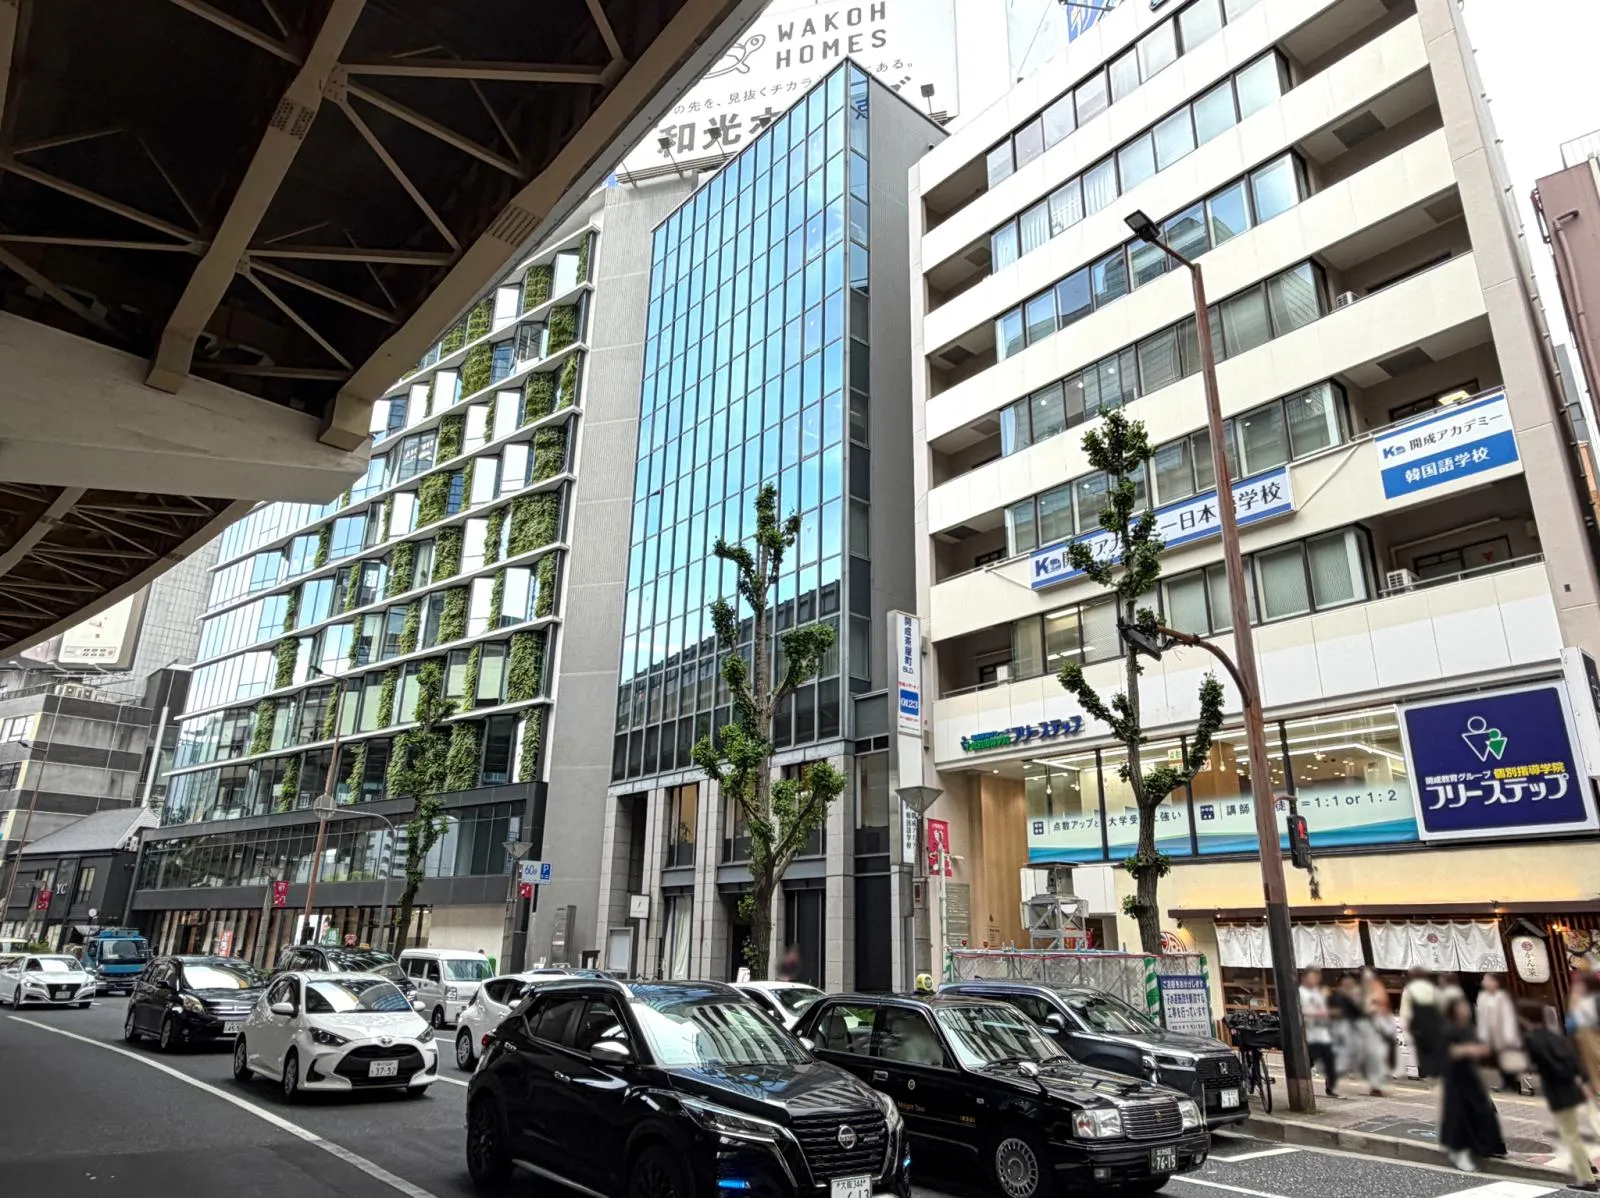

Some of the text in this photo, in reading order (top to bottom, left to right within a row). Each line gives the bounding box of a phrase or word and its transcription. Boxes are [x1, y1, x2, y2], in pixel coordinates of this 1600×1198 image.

[777, 2, 886, 42] WAKOH
[776, 29, 887, 70] HOMES
[673, 74, 823, 115] の先を、見抜くチカラ
[1409, 414, 1503, 451] 開成アカデミー
[1404, 446, 1490, 483] 韓国語学校
[1010, 715, 1083, 745] フリーステップ
[1425, 761, 1566, 785] 開成教育グループ 個別指導学院
[1425, 772, 1569, 810] フリーステップ
[1345, 794, 1361, 806] or
